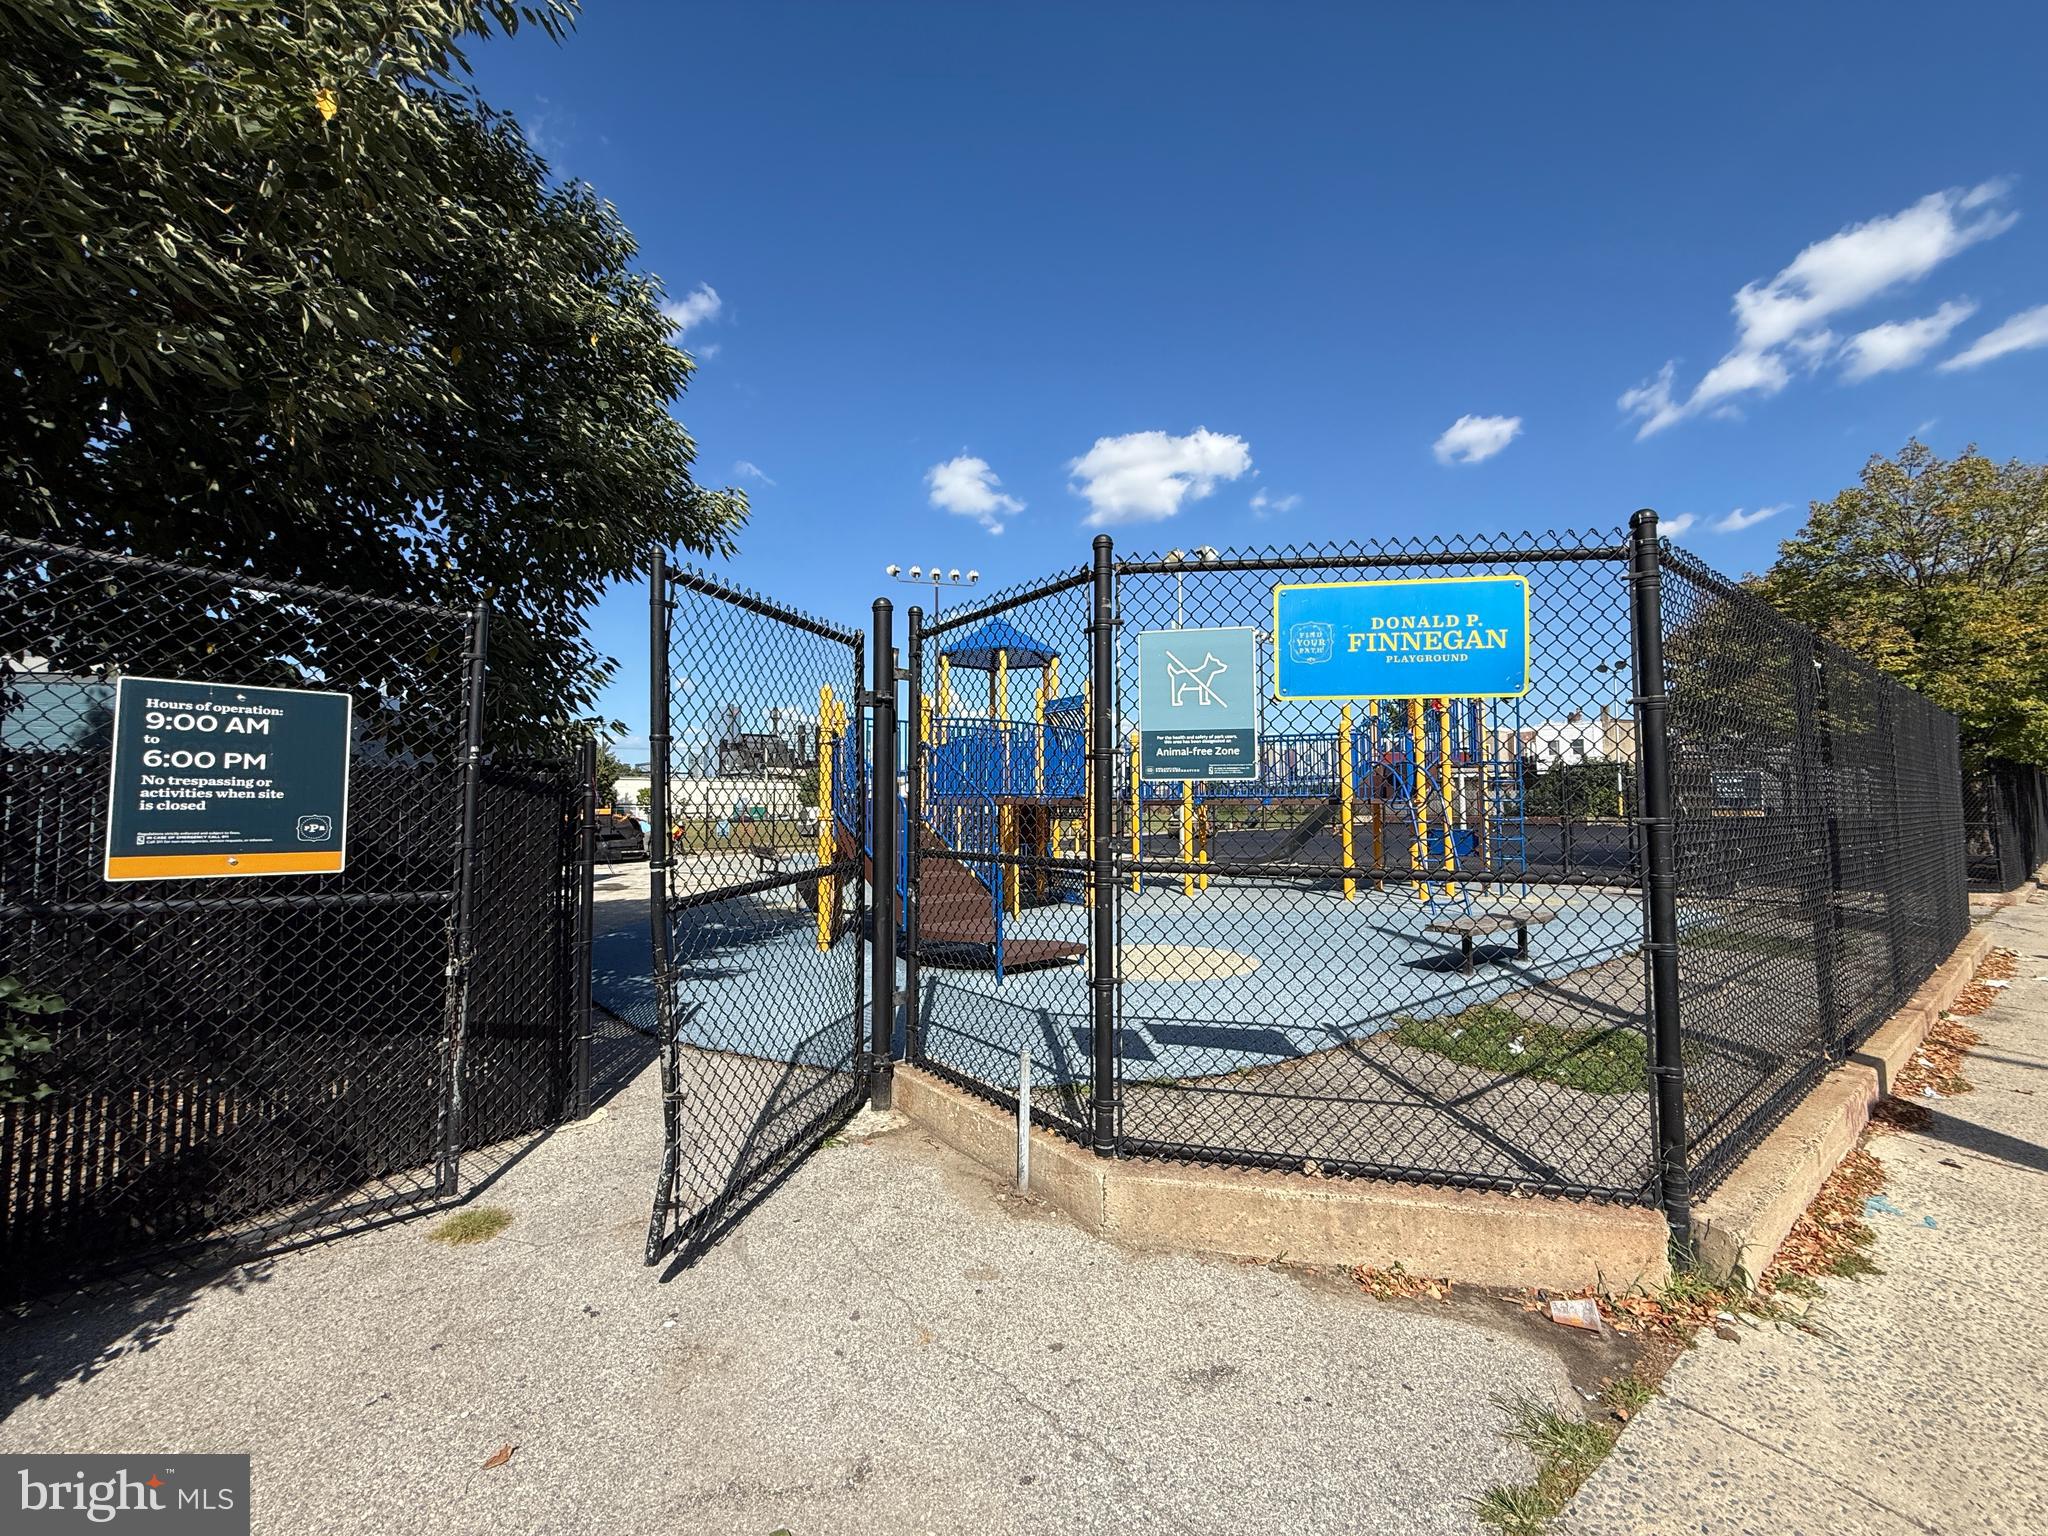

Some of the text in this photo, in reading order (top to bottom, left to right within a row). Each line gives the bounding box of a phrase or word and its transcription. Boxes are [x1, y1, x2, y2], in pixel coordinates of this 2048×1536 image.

[1371, 614, 1483, 630] DONALD P.
[1299, 631, 1323, 639] FIND
[1297, 638, 1326, 647] YOUR
[1347, 629, 1508, 653] FINNEGAN
[1386, 653, 1468, 663] PLAYGROUND
[145, 698, 284, 716] Hours of operation:
[145, 712, 269, 735] 9:00 AM
[143, 734, 160, 744] to
[1156, 746, 1240, 756] Animal-free Zone
[143, 749, 266, 770] 6:00 PM
[140, 774, 273, 788] No trespassing or
[139, 788, 285, 799] activities when site
[138, 800, 206, 811] is closed
